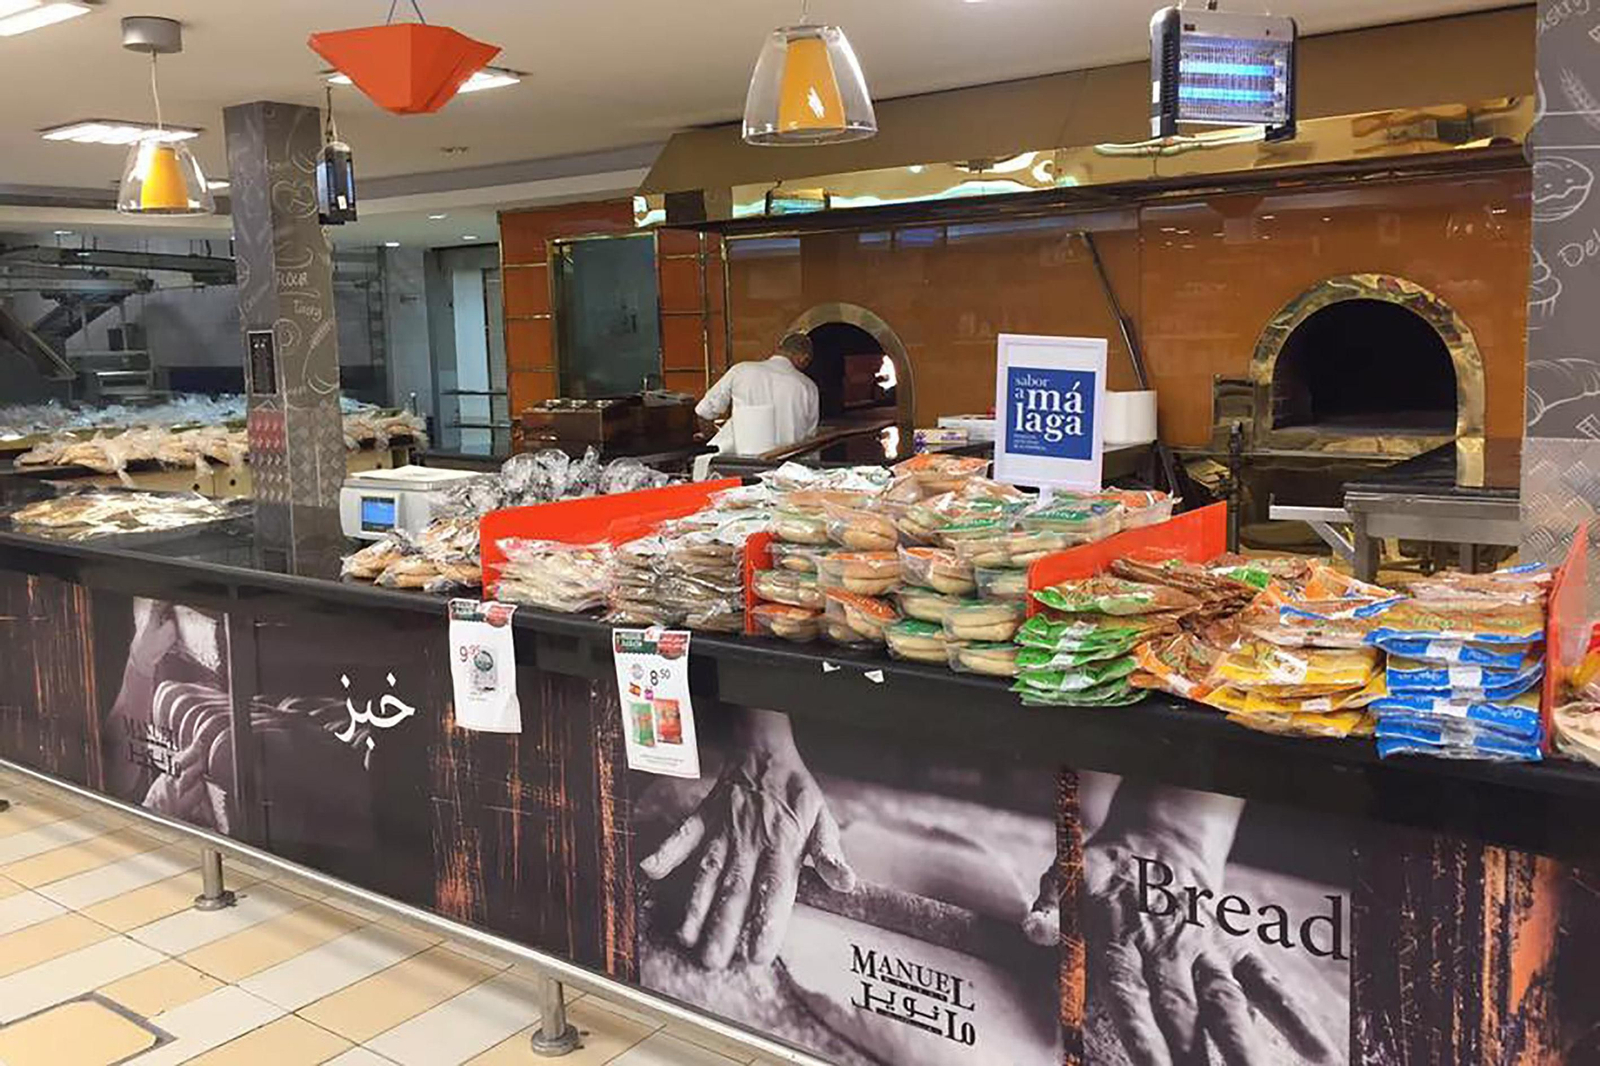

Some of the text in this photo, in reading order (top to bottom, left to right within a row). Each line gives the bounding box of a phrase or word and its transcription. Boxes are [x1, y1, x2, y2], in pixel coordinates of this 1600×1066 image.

[1014, 374, 1049, 387] sabor
[1014, 381, 1085, 414] a má
[1015, 402, 1085, 442] laga
[334, 672, 415, 750] خبز
[1131, 854, 1349, 961] Bread
[851, 943, 975, 1011] MANUEL
